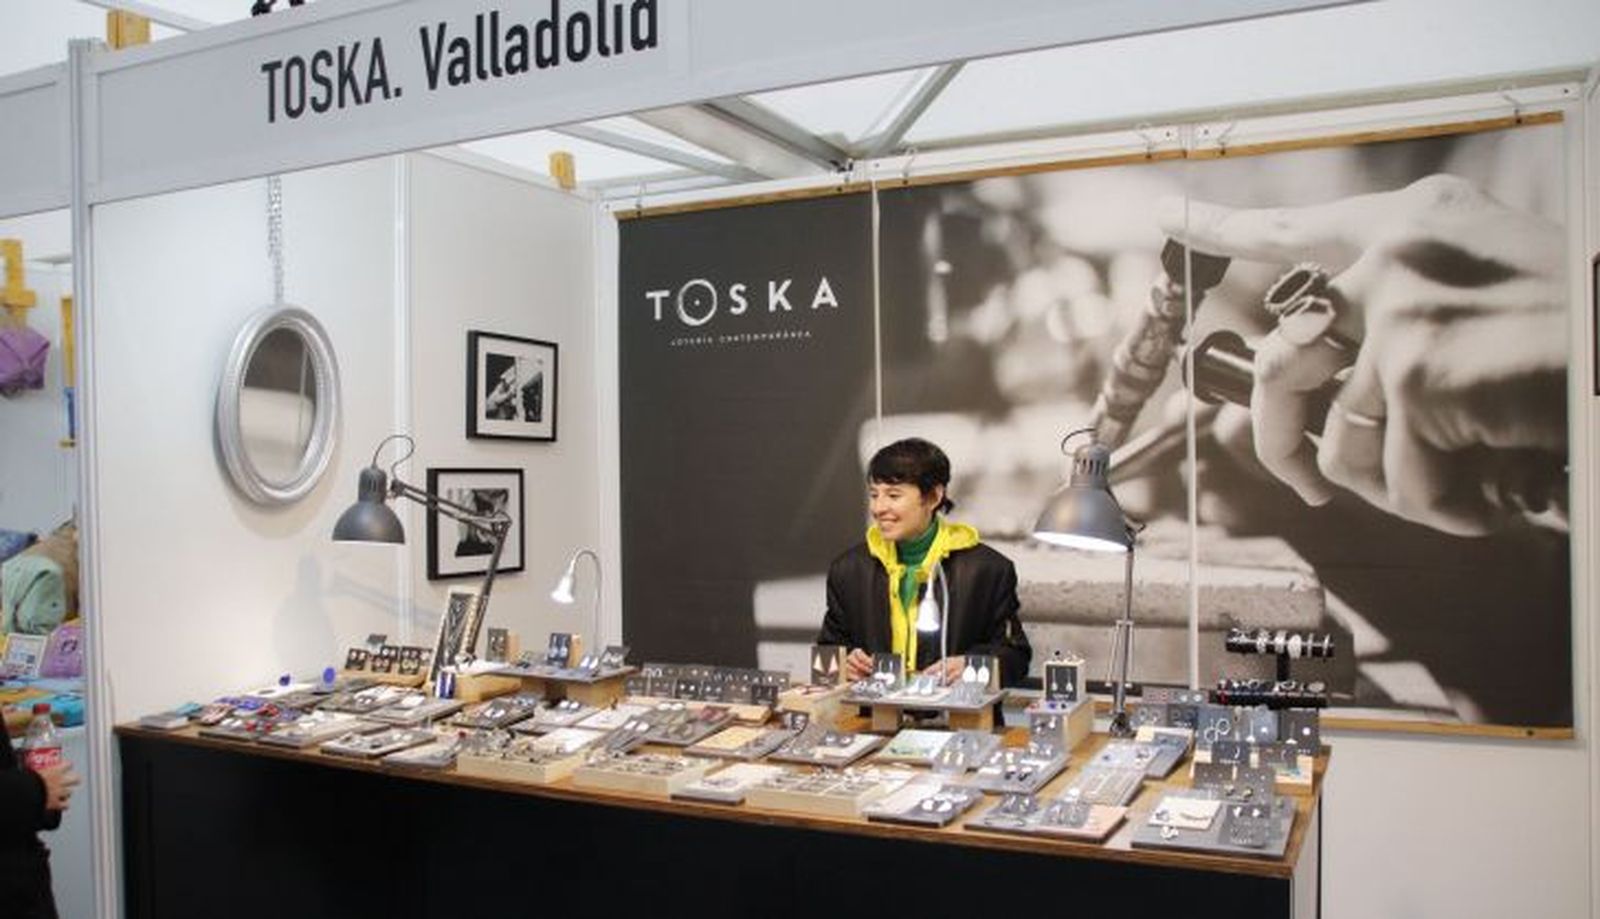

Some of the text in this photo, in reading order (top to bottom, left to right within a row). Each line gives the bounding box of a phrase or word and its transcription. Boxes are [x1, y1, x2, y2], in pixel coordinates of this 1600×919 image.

[261, 0, 659, 123] TOSKA. Valladolid
[645, 276, 838, 326] TOSKA
